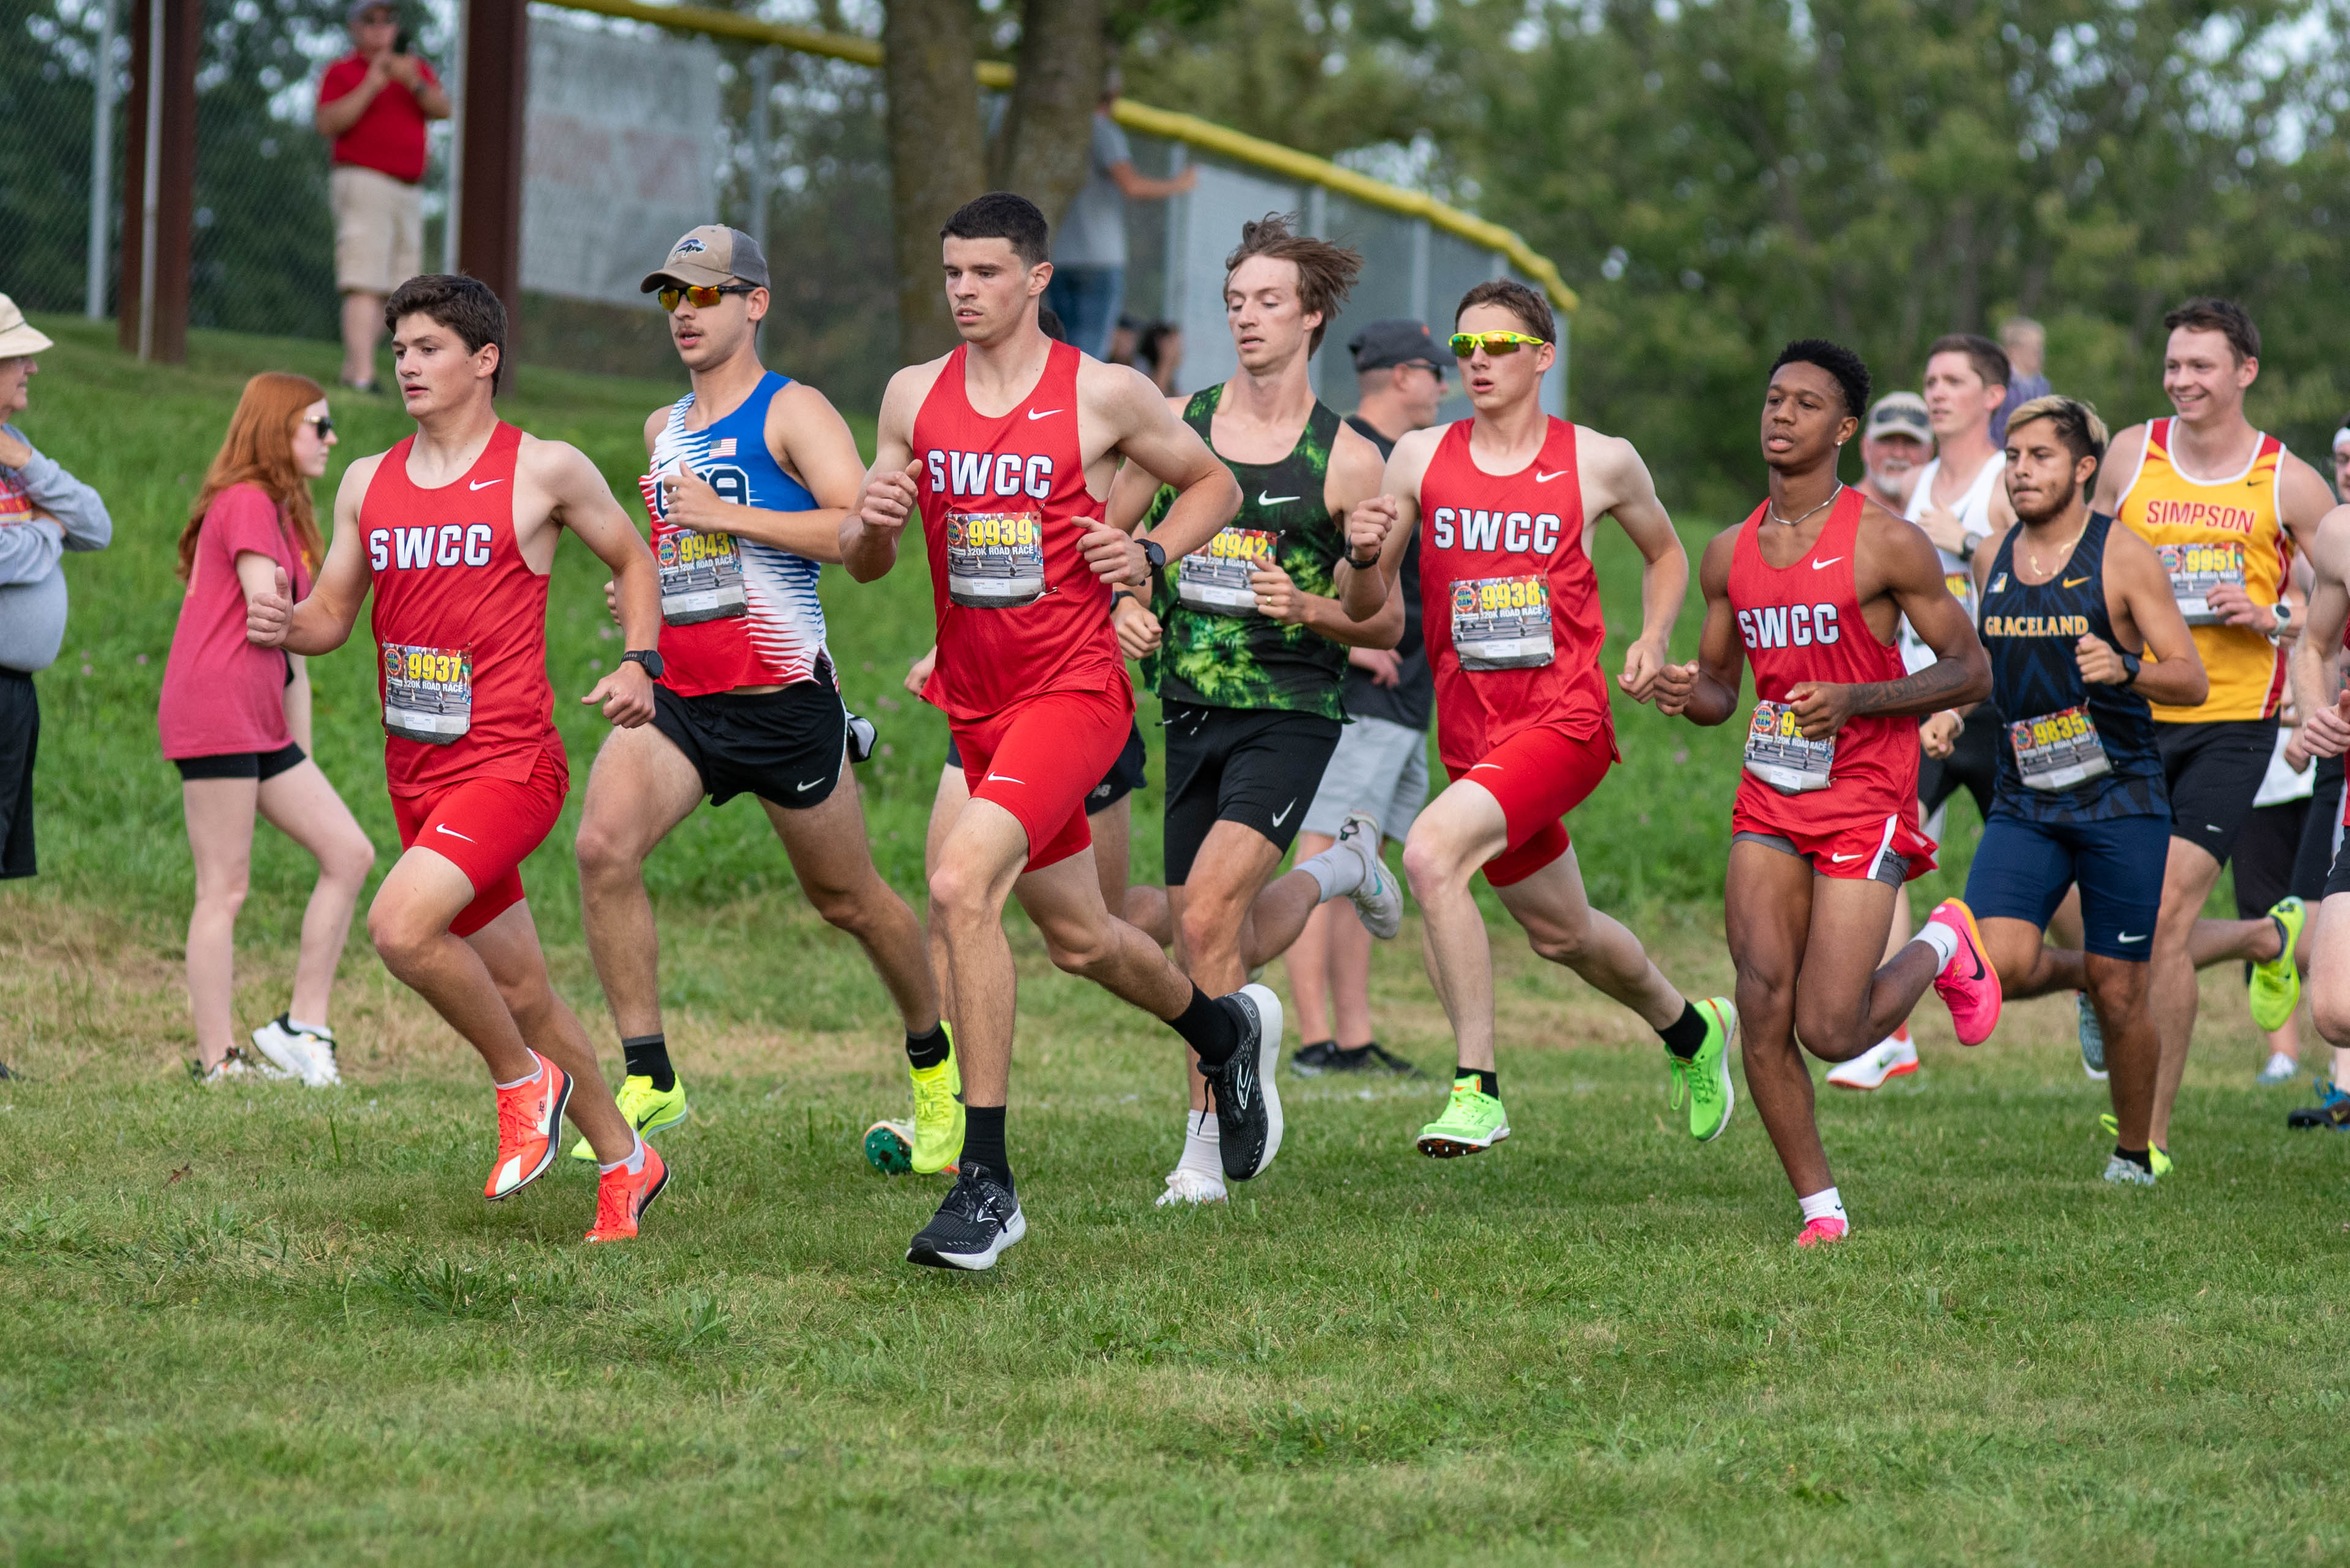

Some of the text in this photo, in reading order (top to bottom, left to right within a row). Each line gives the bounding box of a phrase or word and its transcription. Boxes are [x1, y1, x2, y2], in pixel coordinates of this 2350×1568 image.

[927, 449, 1054, 500] SWCC
[1434, 506, 1561, 555] SWCC
[2146, 500, 2256, 535] SIMPSON
[369, 523, 493, 572] SWCC
[680, 532, 730, 562] 9943
[968, 519, 1034, 547] 9939
[1211, 532, 1268, 560] 9942
[696, 559, 714, 570] ROAD
[715, 555, 734, 566] RACE
[988, 546, 1010, 555] ROAD
[1012, 545, 1034, 555] RACE
[1481, 580, 1541, 610] 9938
[1500, 608, 1520, 619] ROAD
[1522, 605, 1543, 616] RACE
[1738, 602, 1840, 650] SWCC
[1984, 615, 2090, 637] GRACELAND
[408, 653, 462, 682] 9937
[422, 682, 441, 691] ROAD
[442, 682, 463, 693] RACE
[2032, 712, 2088, 746] 9835
[1809, 739, 1828, 752] RACE
